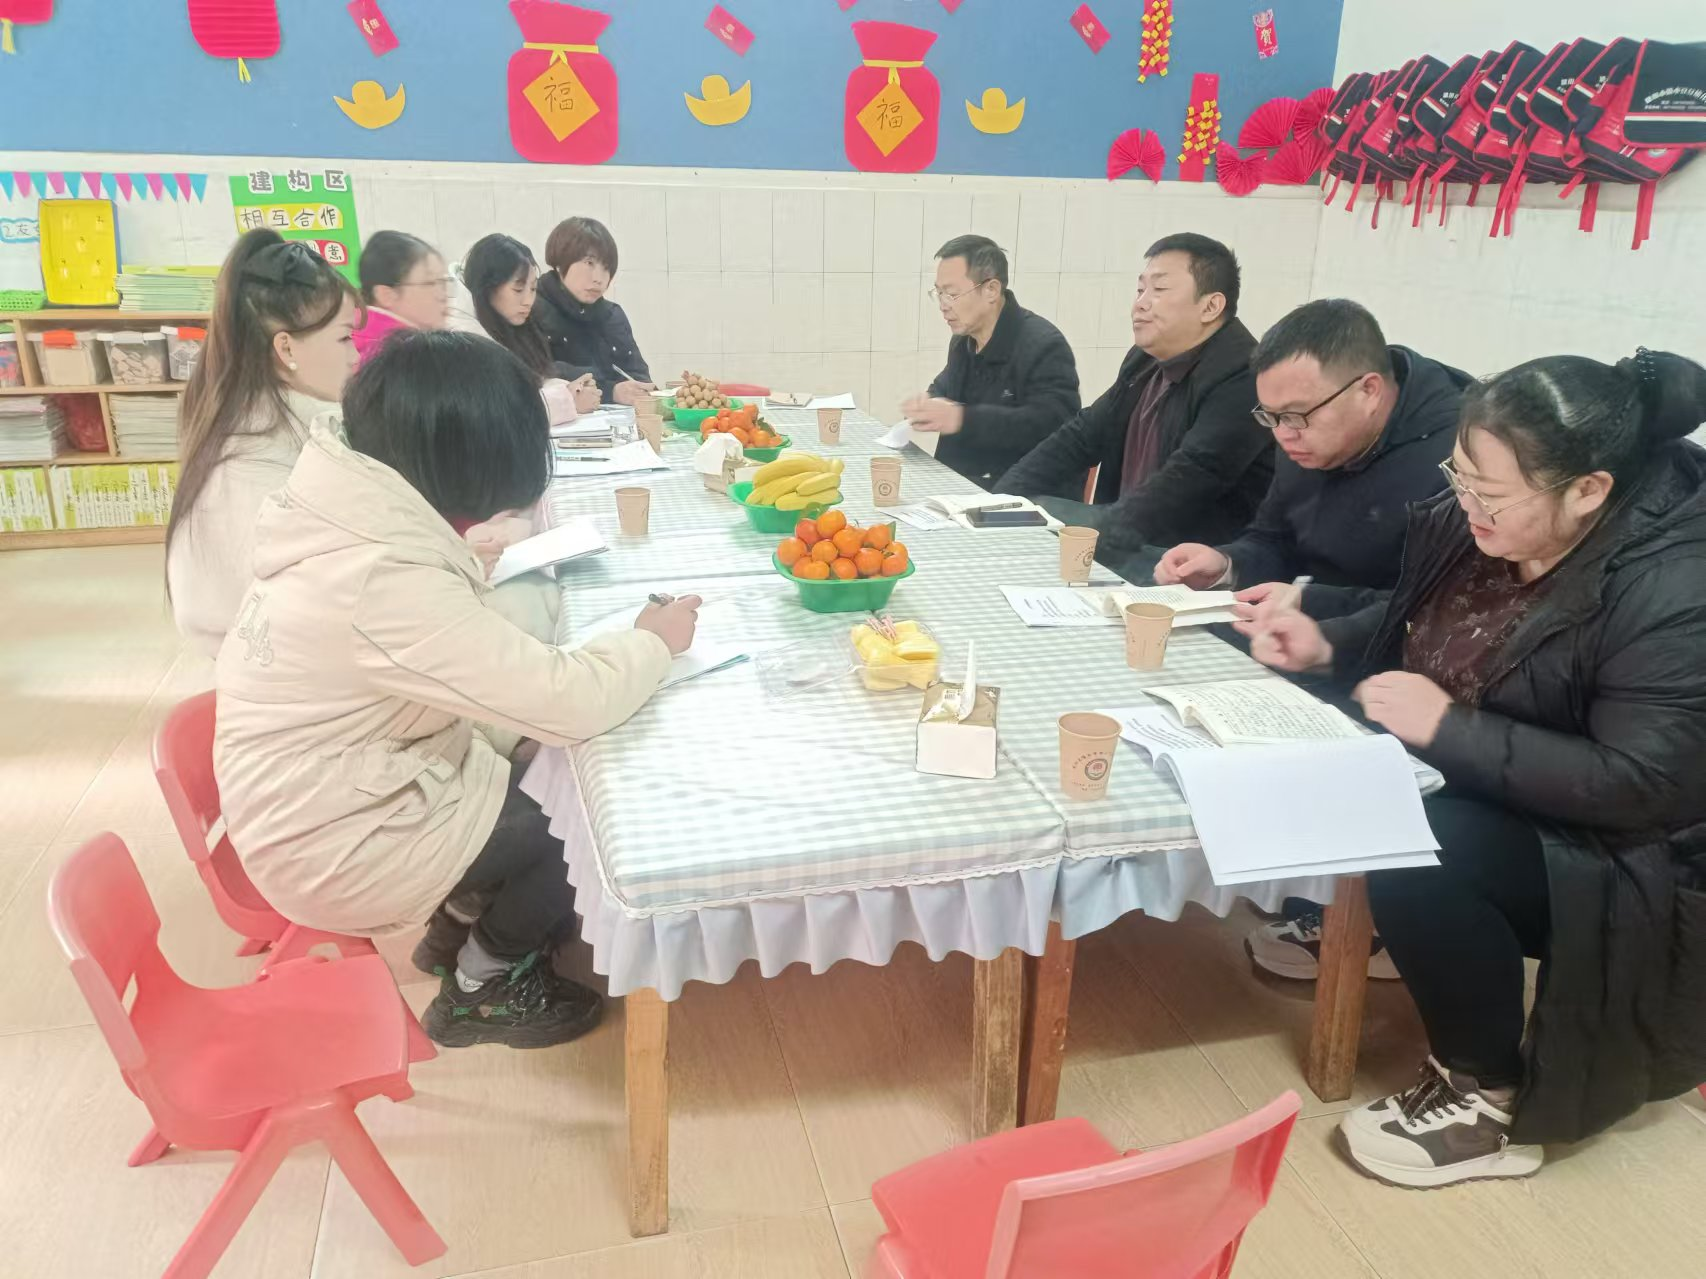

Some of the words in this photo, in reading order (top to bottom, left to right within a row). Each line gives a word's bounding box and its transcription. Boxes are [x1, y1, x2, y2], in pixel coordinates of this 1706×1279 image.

[544, 76, 575, 113] 福
[876, 97, 904, 131] 福
[249, 168, 346, 192] 建构区
[239, 205, 337, 230] 相互合作
